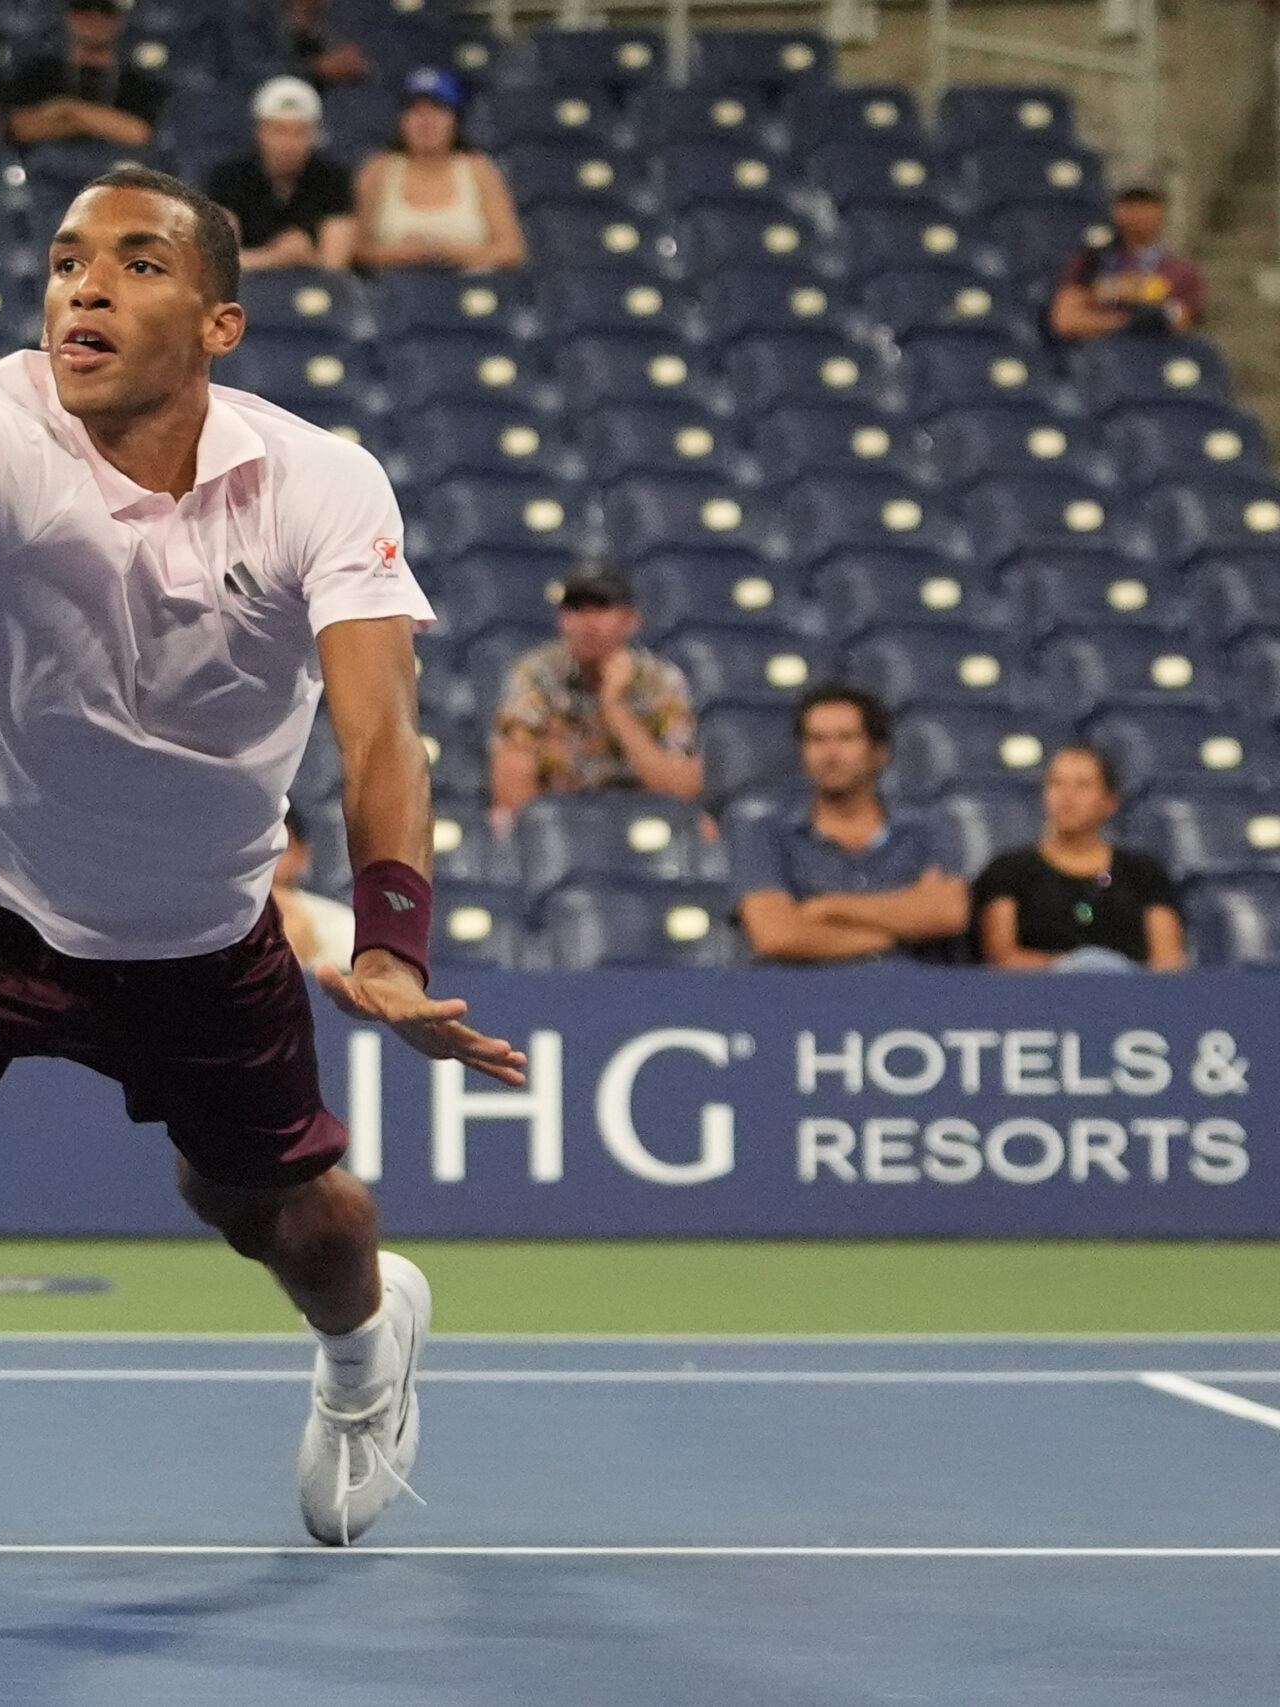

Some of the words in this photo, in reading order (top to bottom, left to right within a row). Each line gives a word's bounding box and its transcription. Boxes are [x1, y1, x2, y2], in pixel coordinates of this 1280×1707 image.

[795, 1030, 1173, 1096] HOTELS
[1191, 1030, 1251, 1097] &
[347, 1028, 736, 1186] IHG
[795, 1118, 1250, 1185] RESORTS
